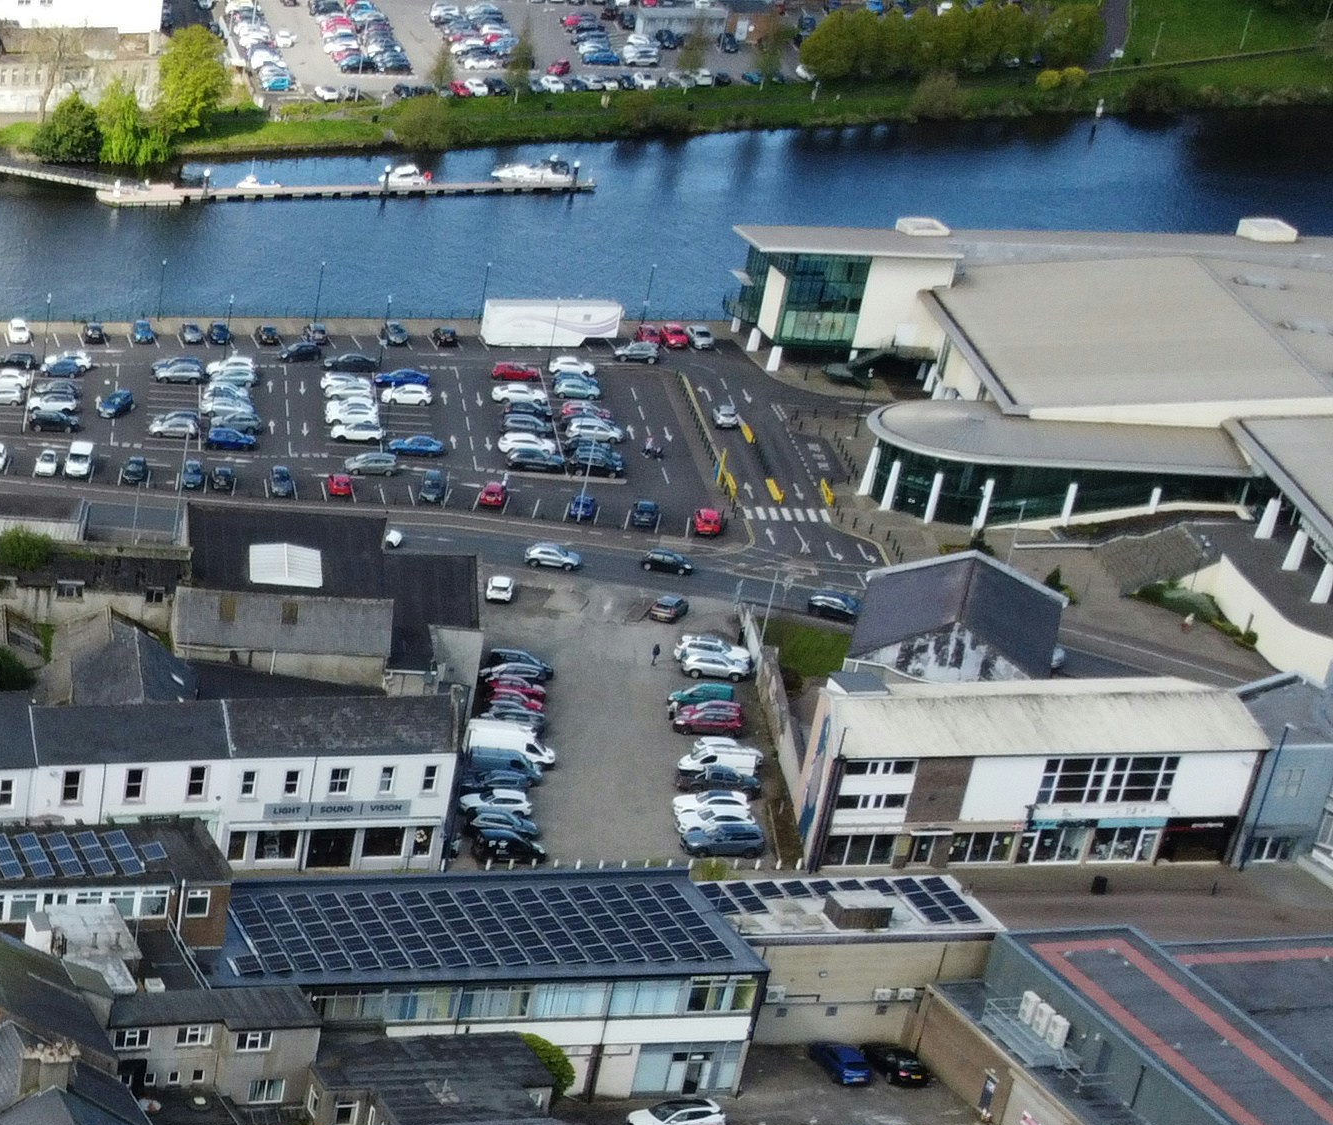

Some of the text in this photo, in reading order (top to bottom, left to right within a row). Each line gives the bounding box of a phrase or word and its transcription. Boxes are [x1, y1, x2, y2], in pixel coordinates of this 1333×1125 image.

[273, 803, 403, 815] LIGHT SOUND VISION
